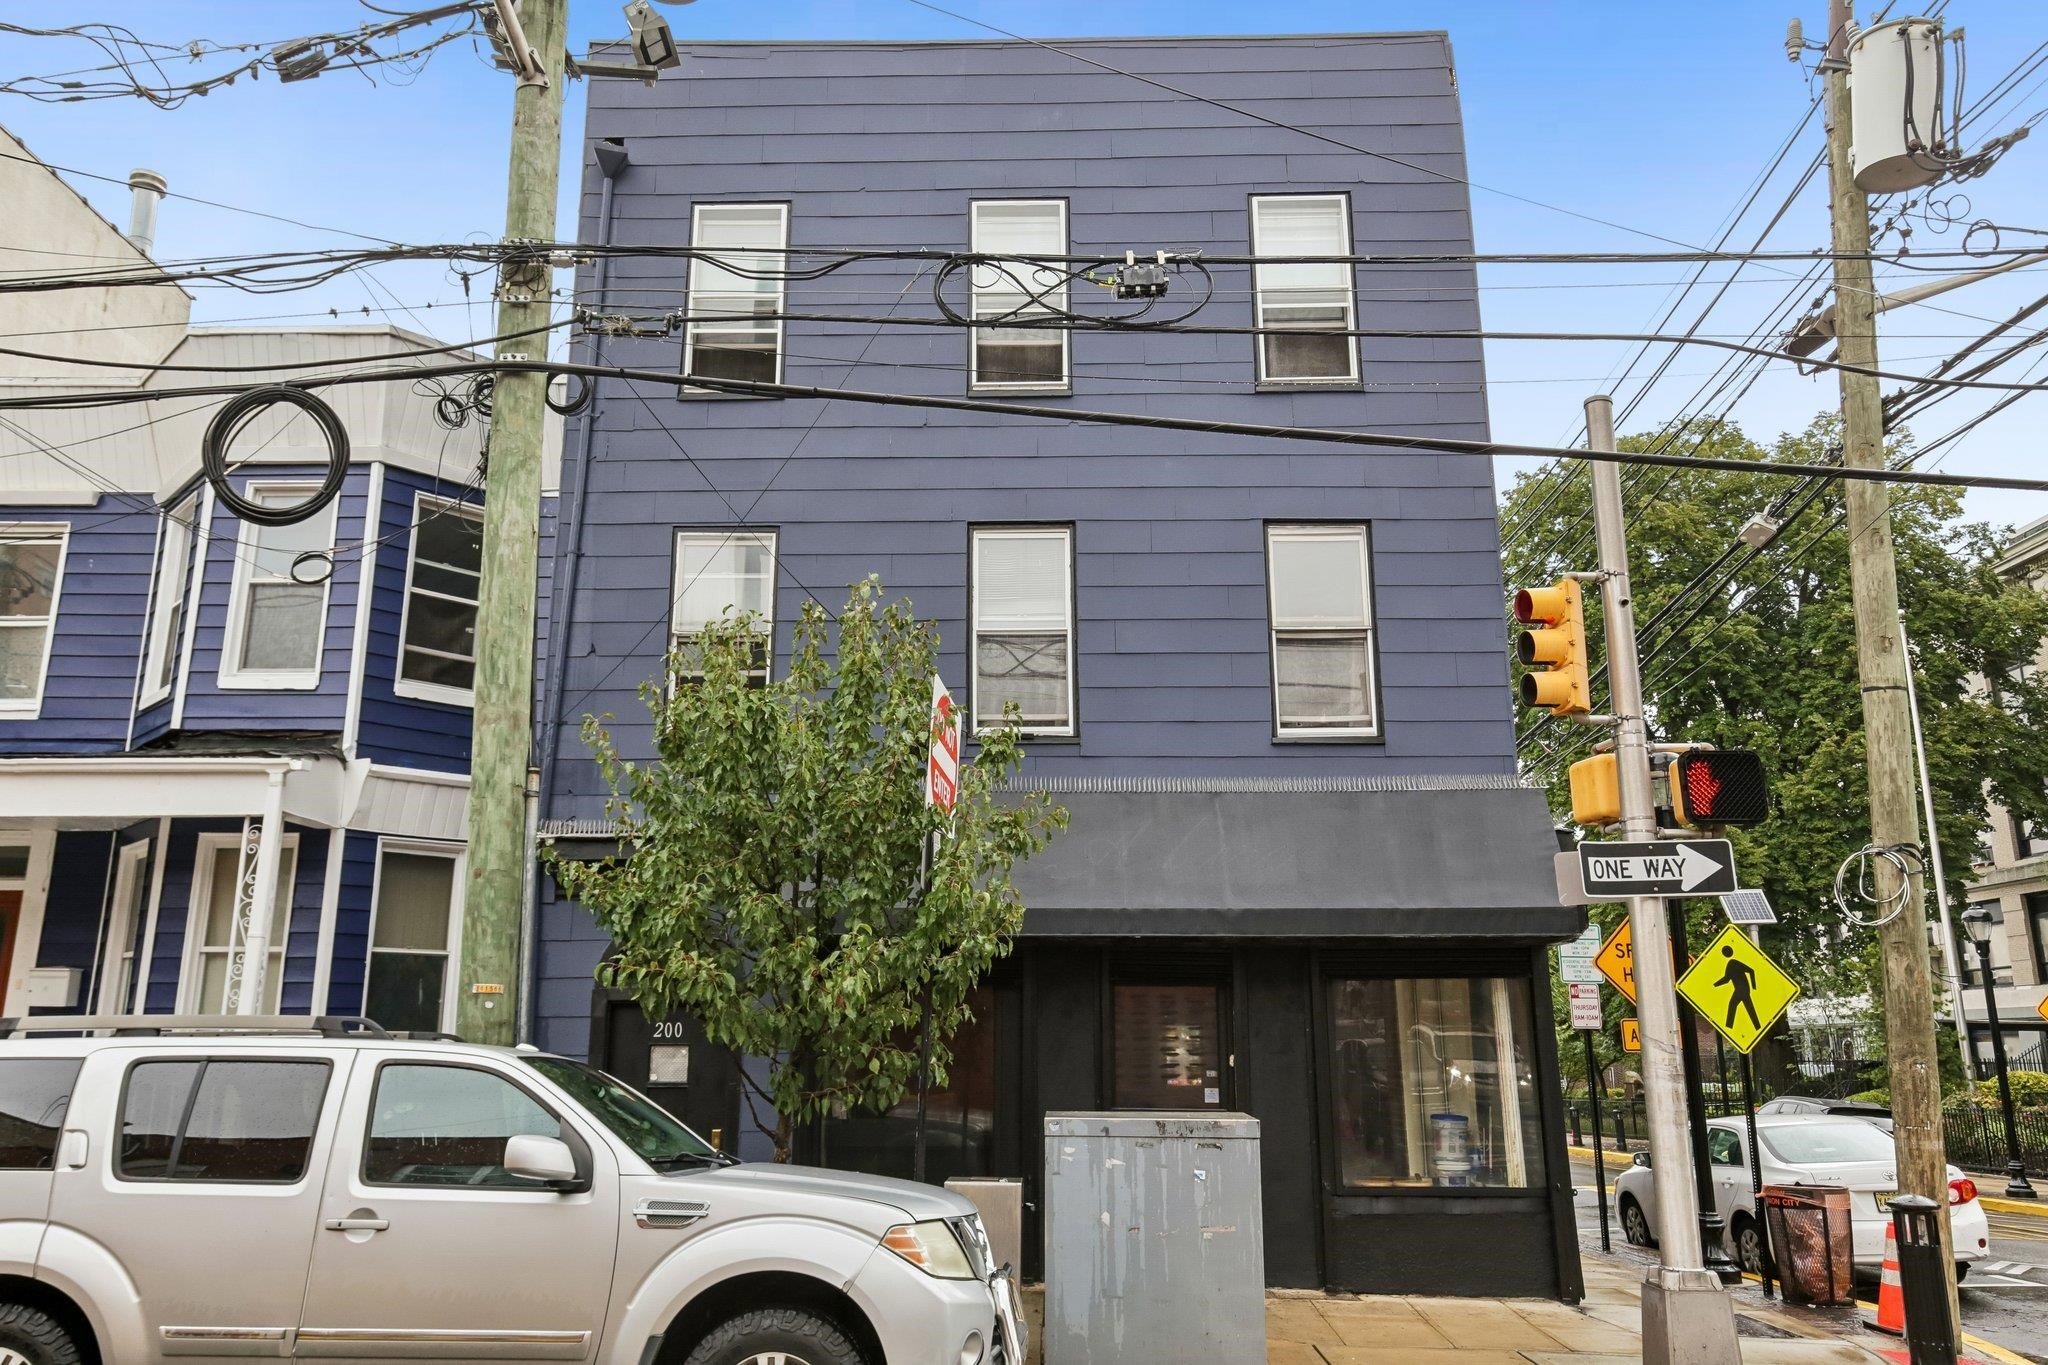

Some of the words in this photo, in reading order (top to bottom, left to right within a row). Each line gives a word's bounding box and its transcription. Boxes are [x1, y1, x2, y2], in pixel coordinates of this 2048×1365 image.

[933, 768, 951, 810] ENTER
[1593, 859, 1633, 879] ONE
[1643, 857, 1687, 878] WAY
[653, 1022, 683, 1038] 200
[1782, 1198, 1800, 1207] CITY
